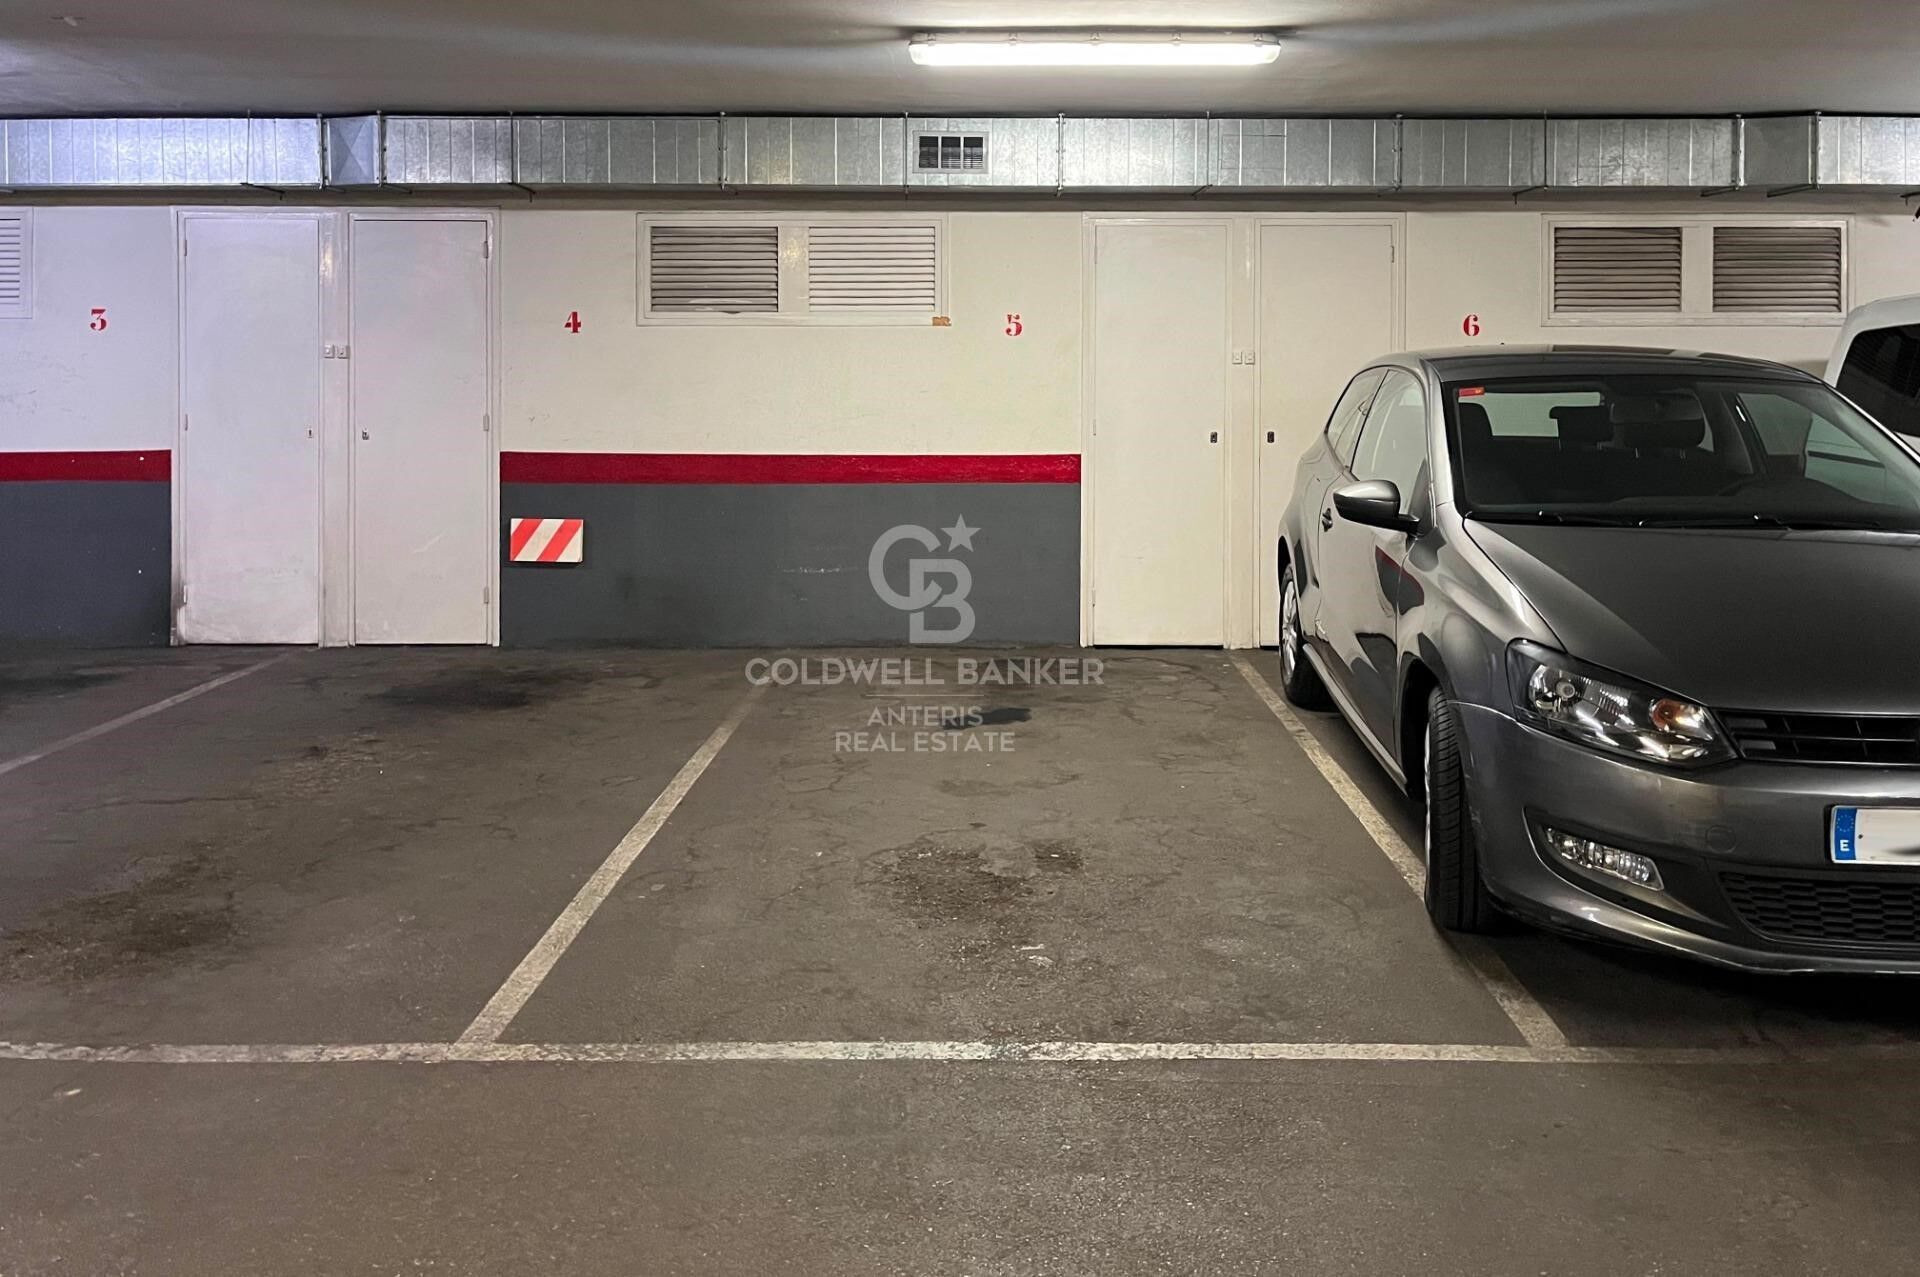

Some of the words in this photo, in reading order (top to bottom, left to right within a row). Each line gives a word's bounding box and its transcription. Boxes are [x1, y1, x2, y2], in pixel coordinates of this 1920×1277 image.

[90, 308, 108, 331] 3
[564, 311, 582, 333] 4
[1005, 314, 1023, 337] 5
[1462, 314, 1480, 337] 6
[1839, 839, 1851, 852] E
